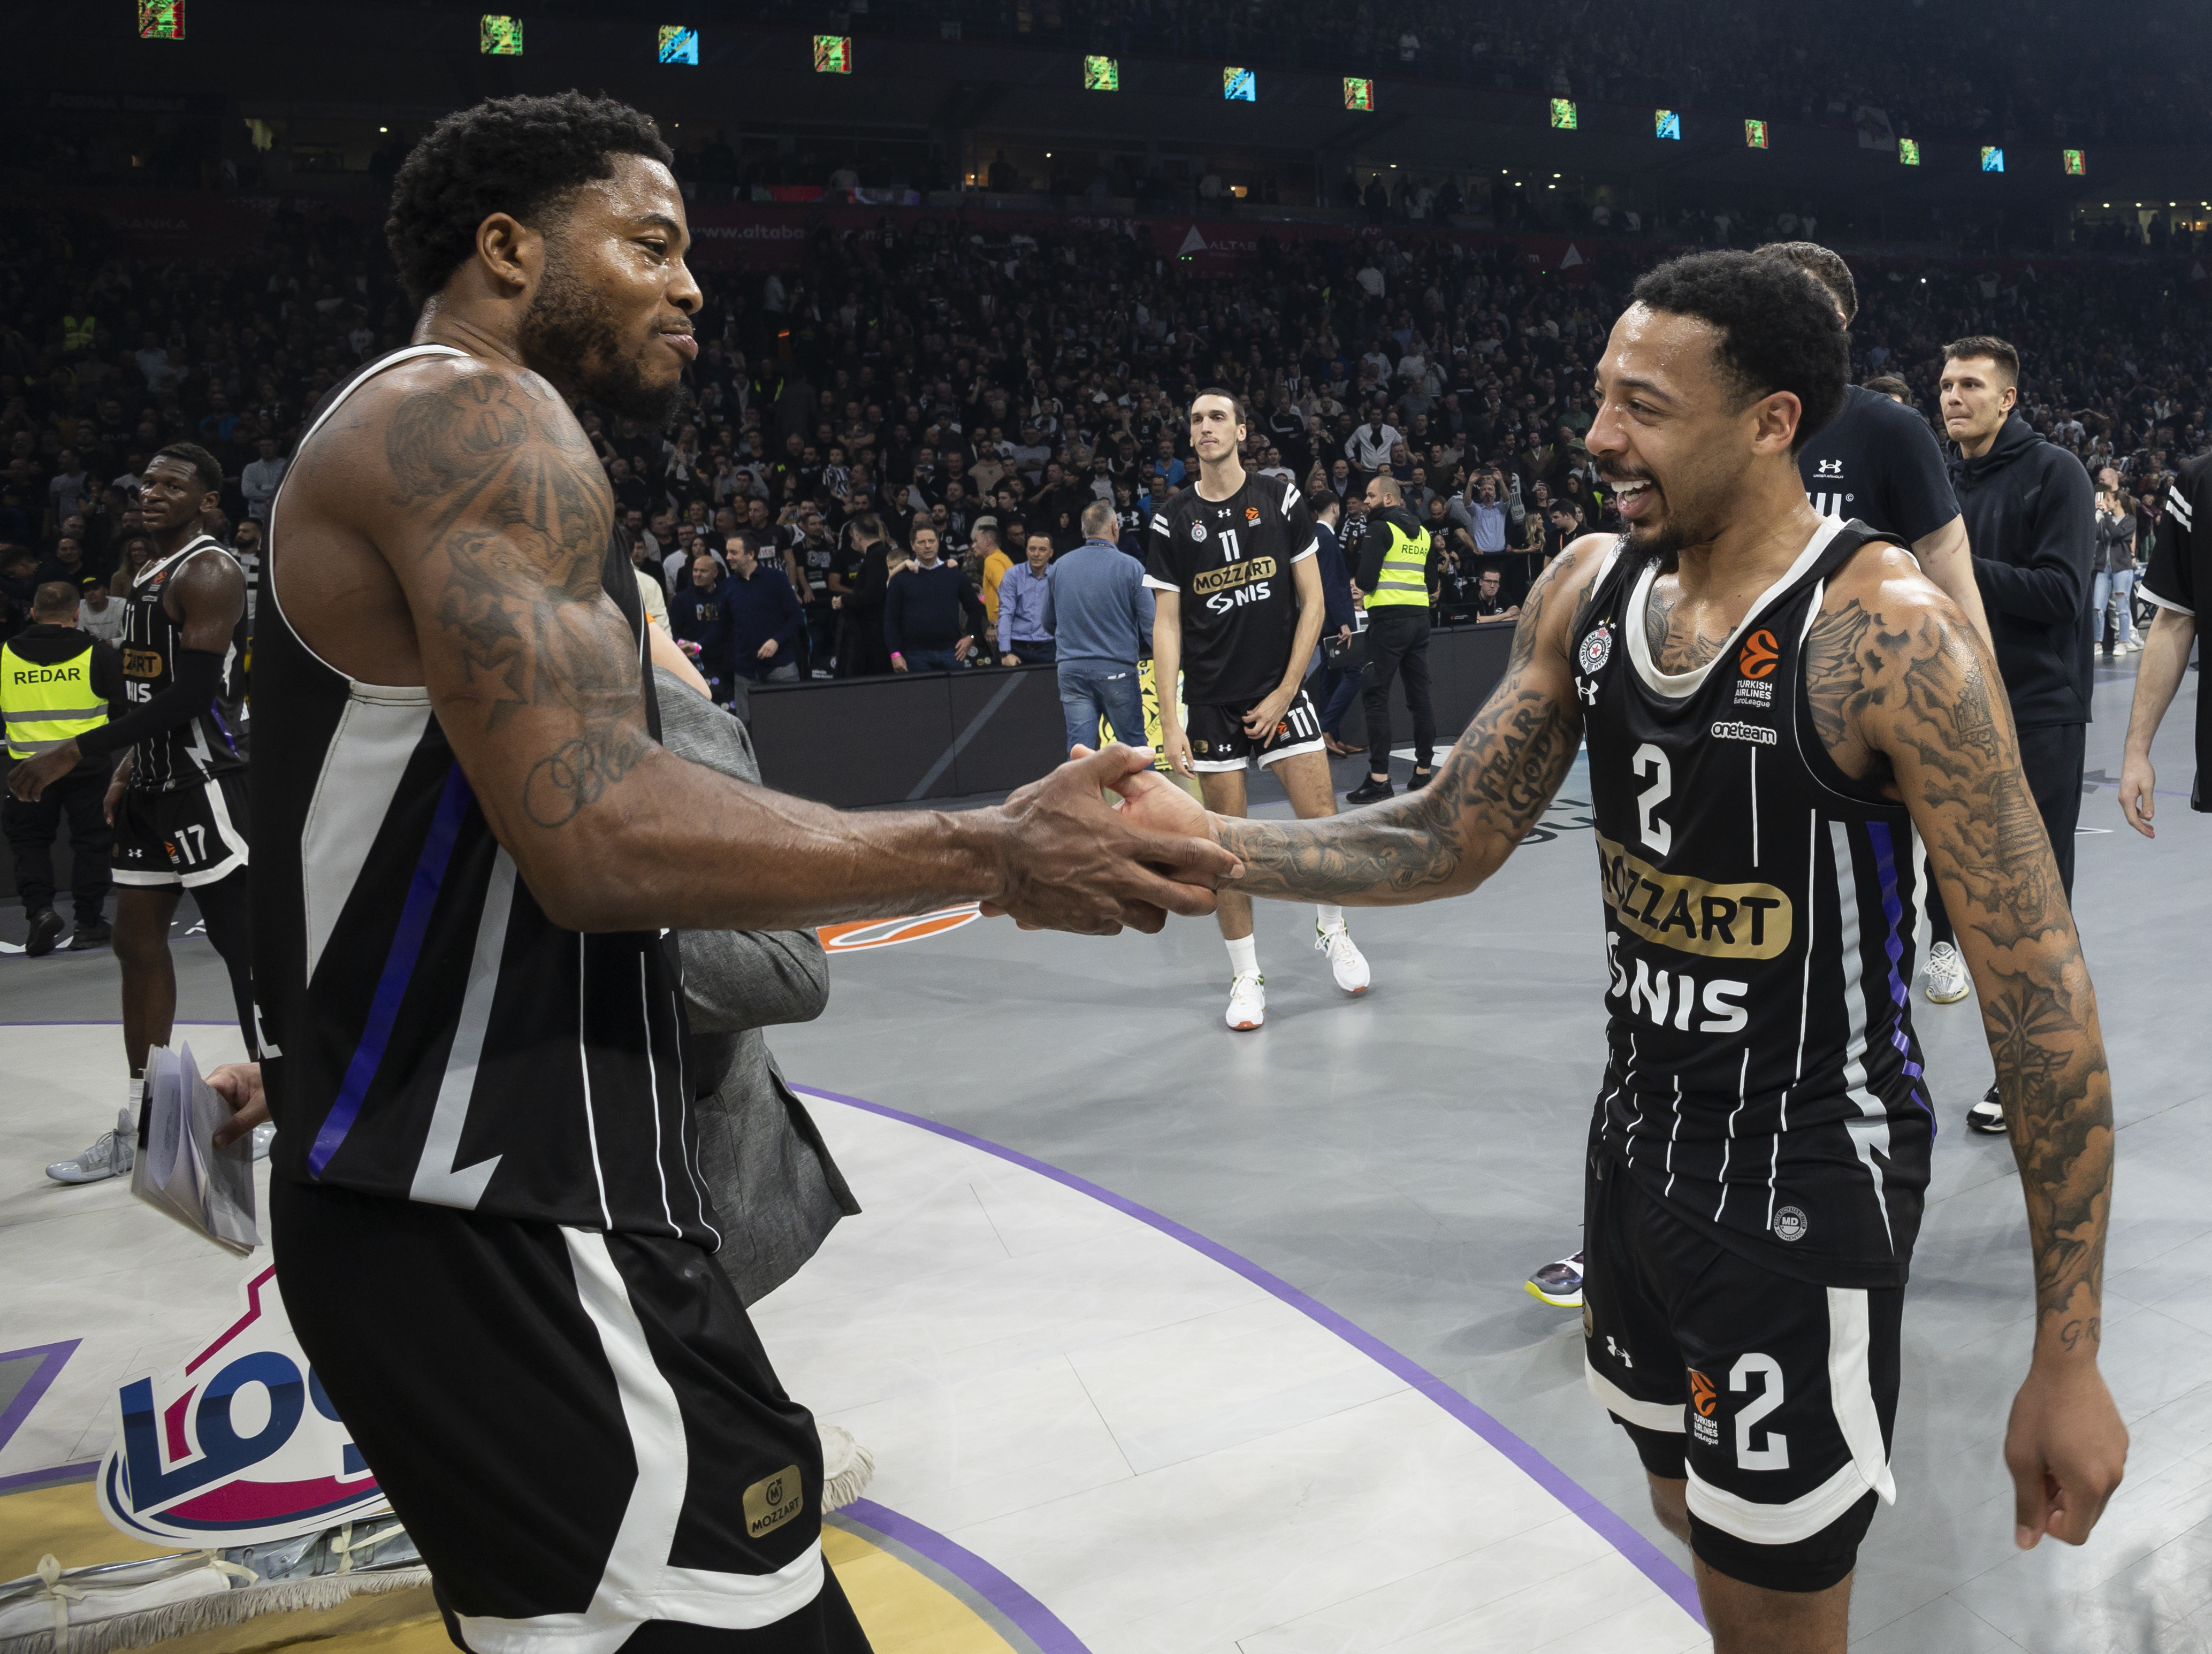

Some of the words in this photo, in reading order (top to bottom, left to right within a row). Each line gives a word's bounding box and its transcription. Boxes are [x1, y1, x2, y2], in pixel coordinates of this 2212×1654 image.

[1218, 529, 1240, 562] 11
[1196, 560, 1272, 591] MOZZART
[1234, 581, 1271, 606] NIS
[14, 668, 81, 685] REDAR
[126, 653, 157, 673] ZART
[1735, 688, 1771, 700] AIRLINES
[1737, 680, 1773, 691] TURKISH
[1734, 697, 1770, 708] EuroLeague
[1287, 707, 1313, 738] 11
[1711, 722, 1776, 745] oneteam
[1474, 708, 1547, 802] FEAR
[1508, 734, 1553, 812] GOD
[1633, 743, 1672, 856] 2
[174, 824, 207, 865] 17
[1630, 958, 1748, 1033] NIS
[1776, 1229, 1804, 1240] AUTHENTIC
[1782, 1216, 1798, 1226] MD
[1729, 1352, 1790, 1471] 2
[752, 1496, 800, 1533] MOZZART
